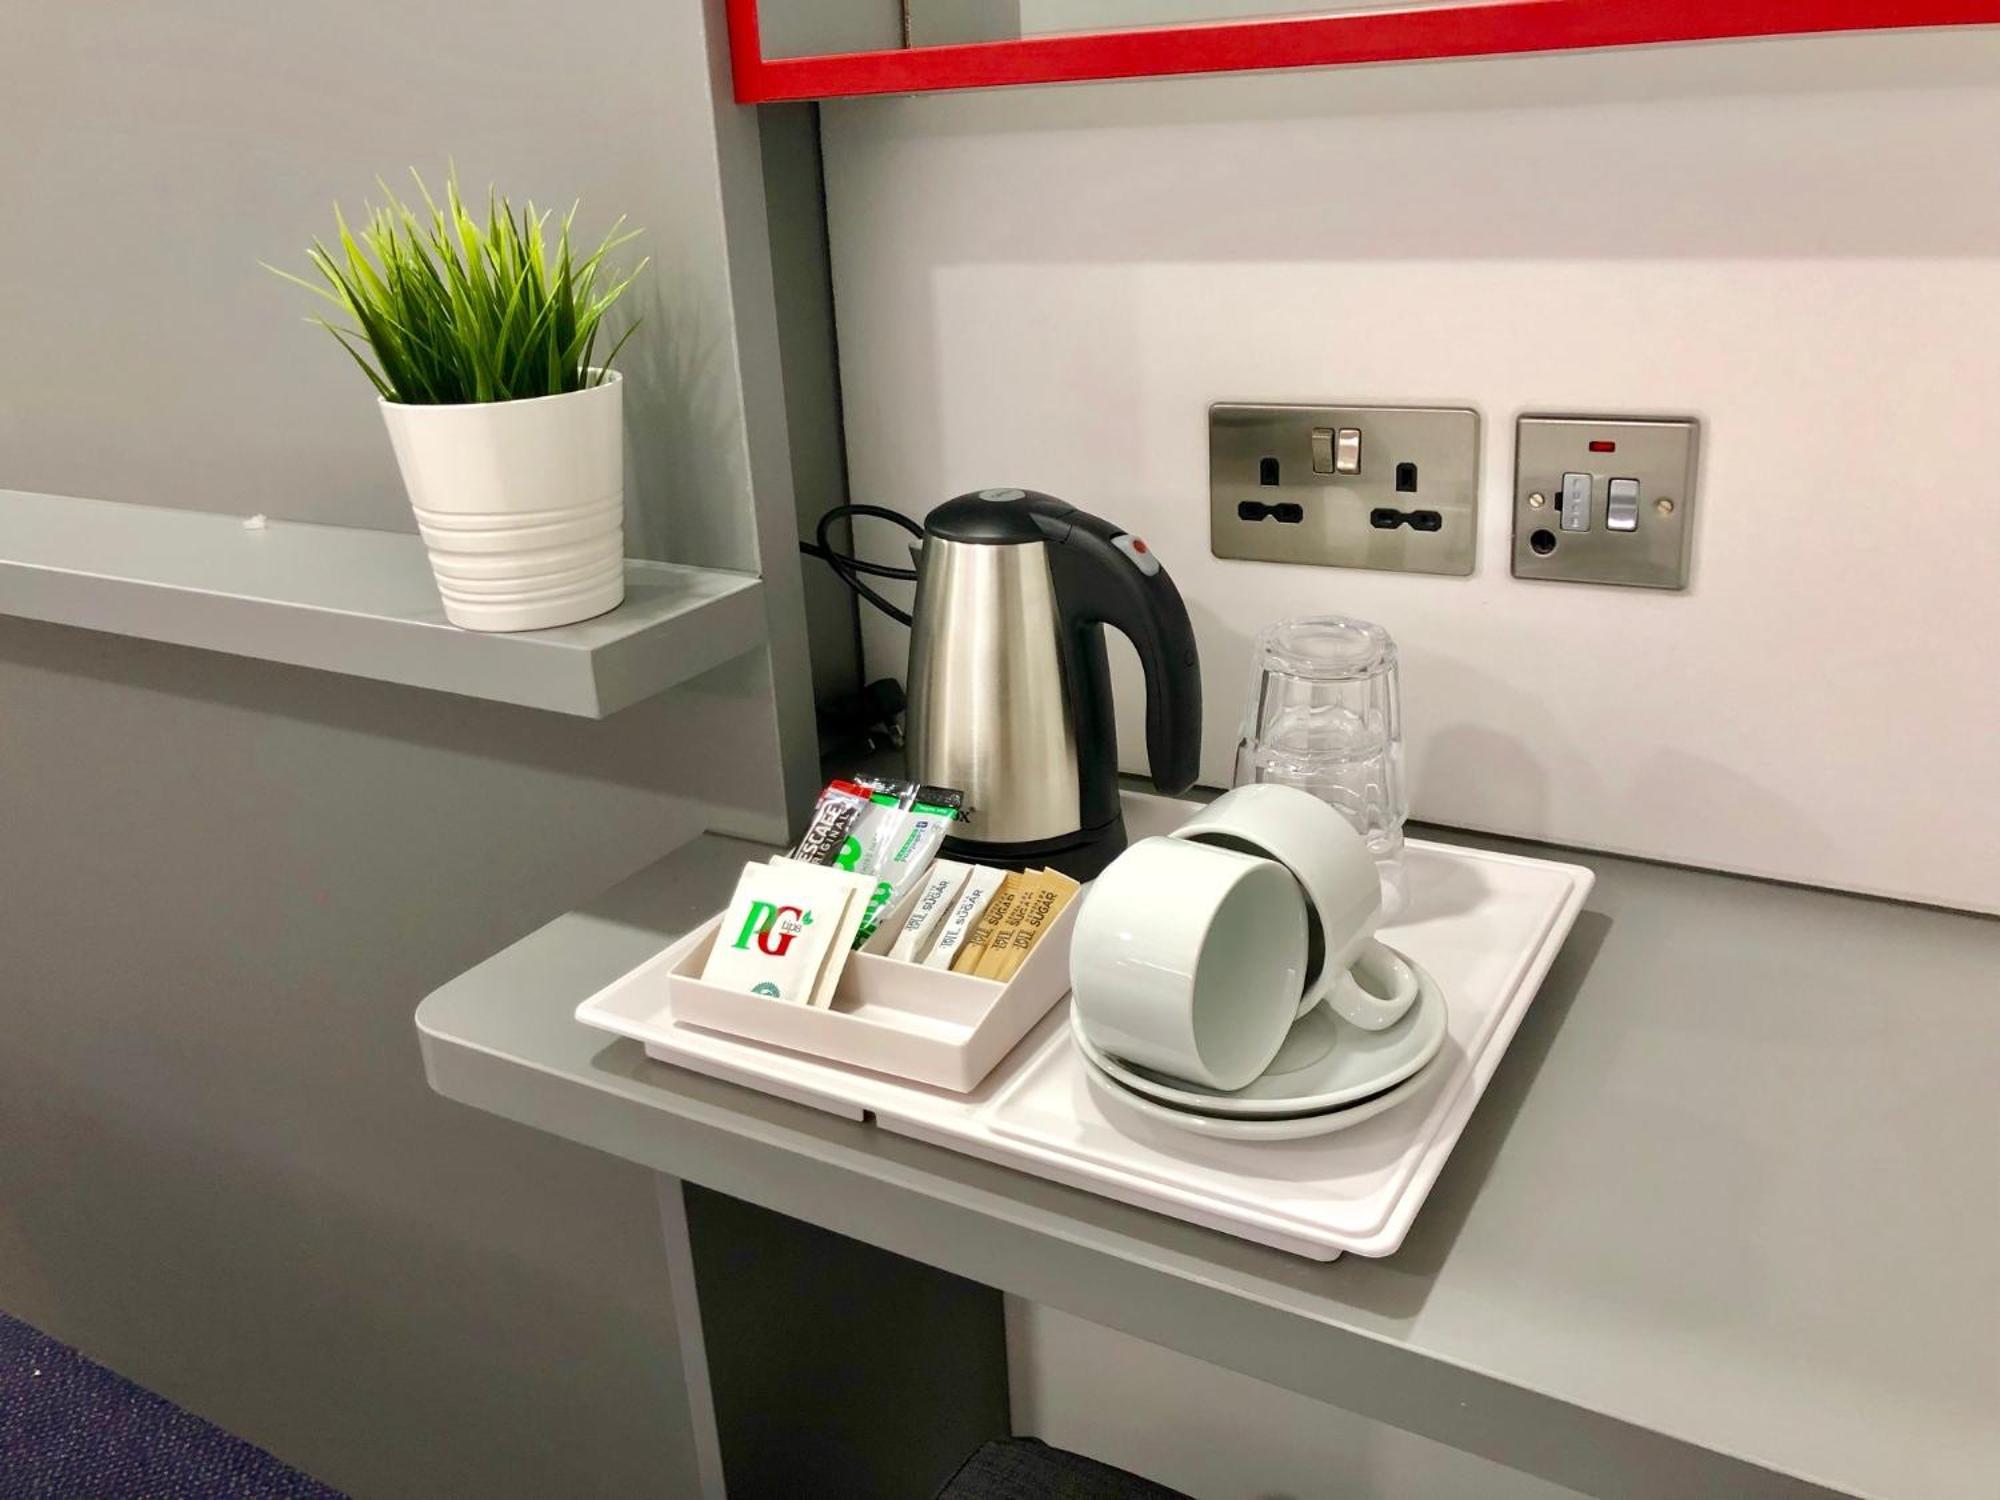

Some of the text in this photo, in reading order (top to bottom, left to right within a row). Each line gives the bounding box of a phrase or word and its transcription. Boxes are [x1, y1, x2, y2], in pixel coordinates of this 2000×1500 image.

[812, 808, 851, 865] RIGINAL
[923, 881, 950, 912] SUGAR
[955, 889, 984, 926] SUGAR
[1030, 892, 1058, 928] SUGAR
[731, 900, 803, 956] PG
